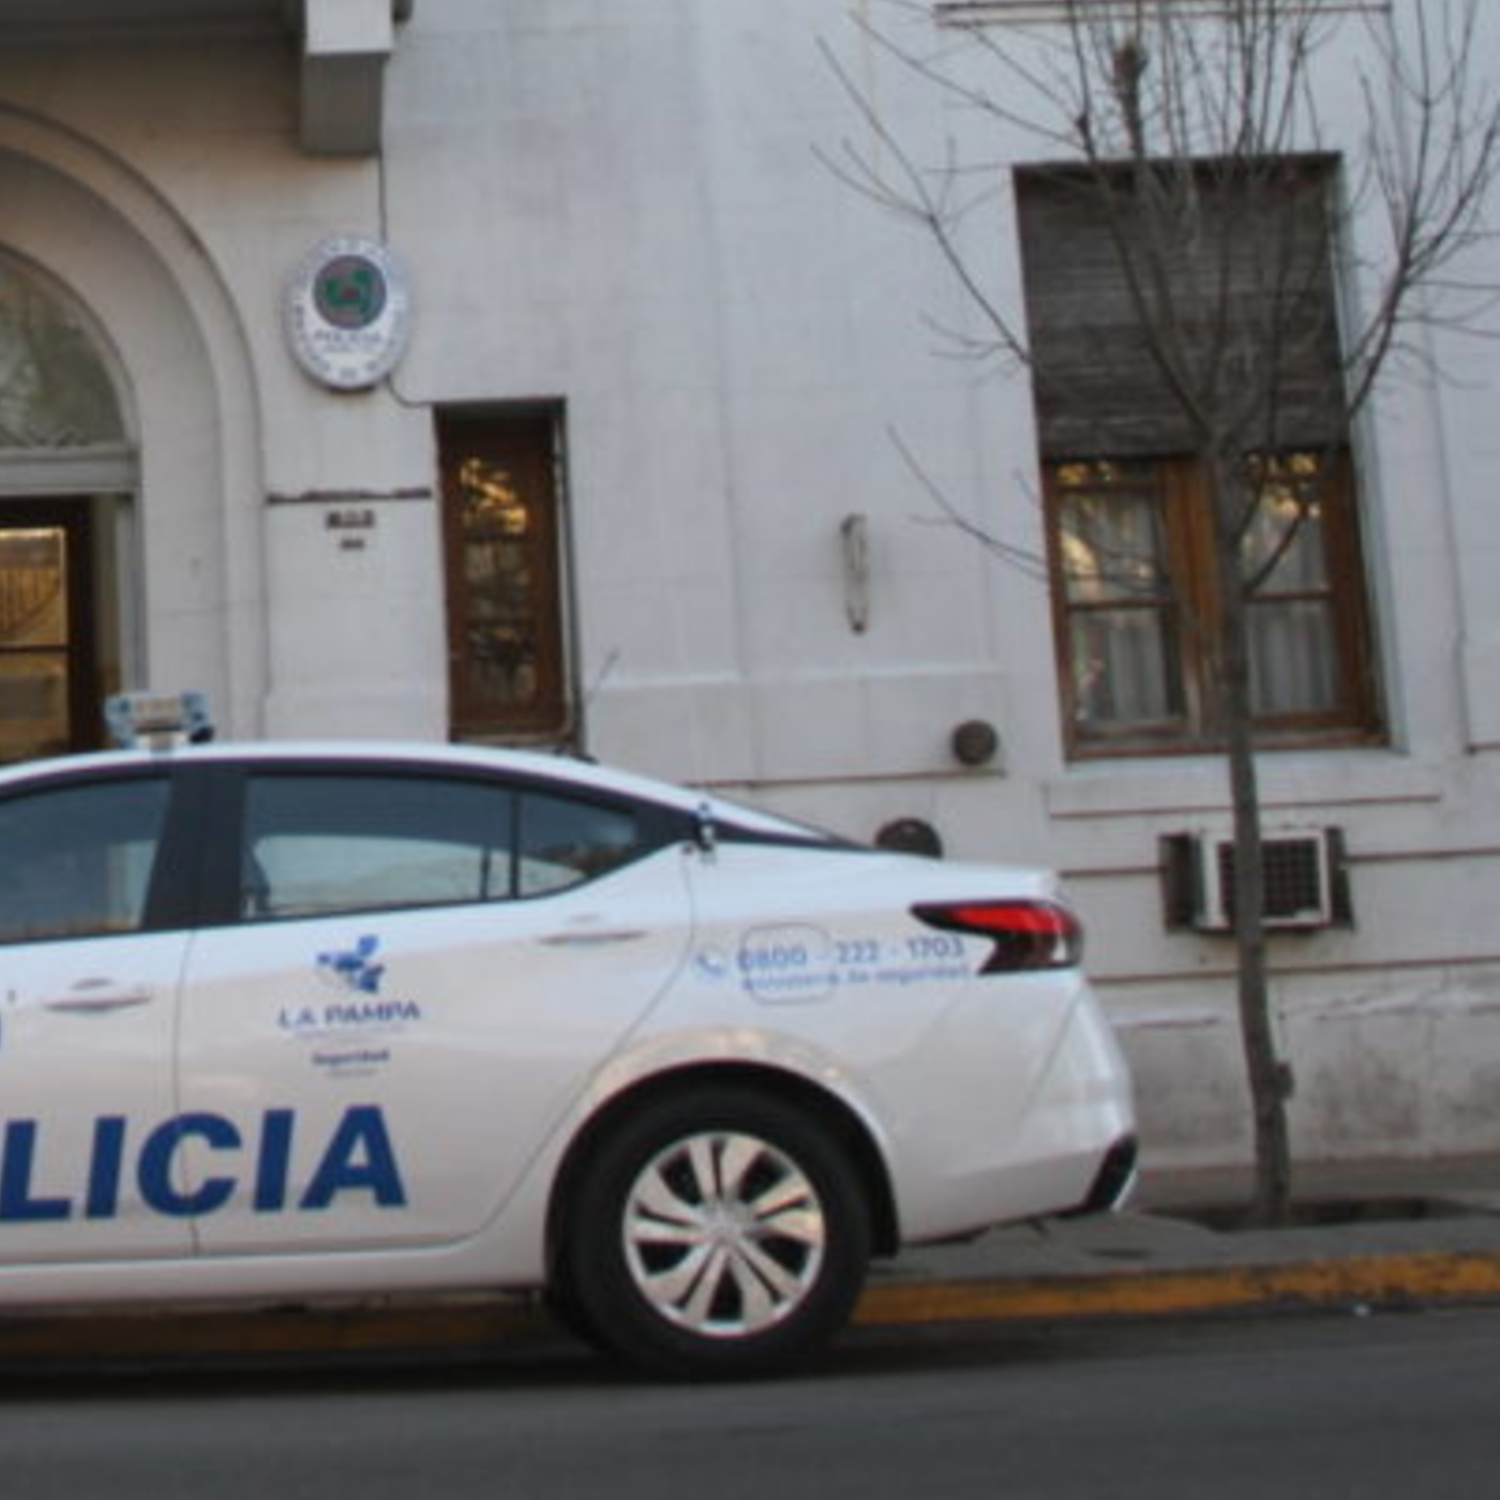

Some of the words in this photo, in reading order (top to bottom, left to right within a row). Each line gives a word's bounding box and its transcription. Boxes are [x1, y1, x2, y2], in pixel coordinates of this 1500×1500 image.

[737, 943, 808, 971] 0800
[835, 939, 879, 964] 222
[906, 936, 965, 960] 1703
[278, 1006, 316, 1028] LA
[324, 999, 421, 1024] PAMPA
